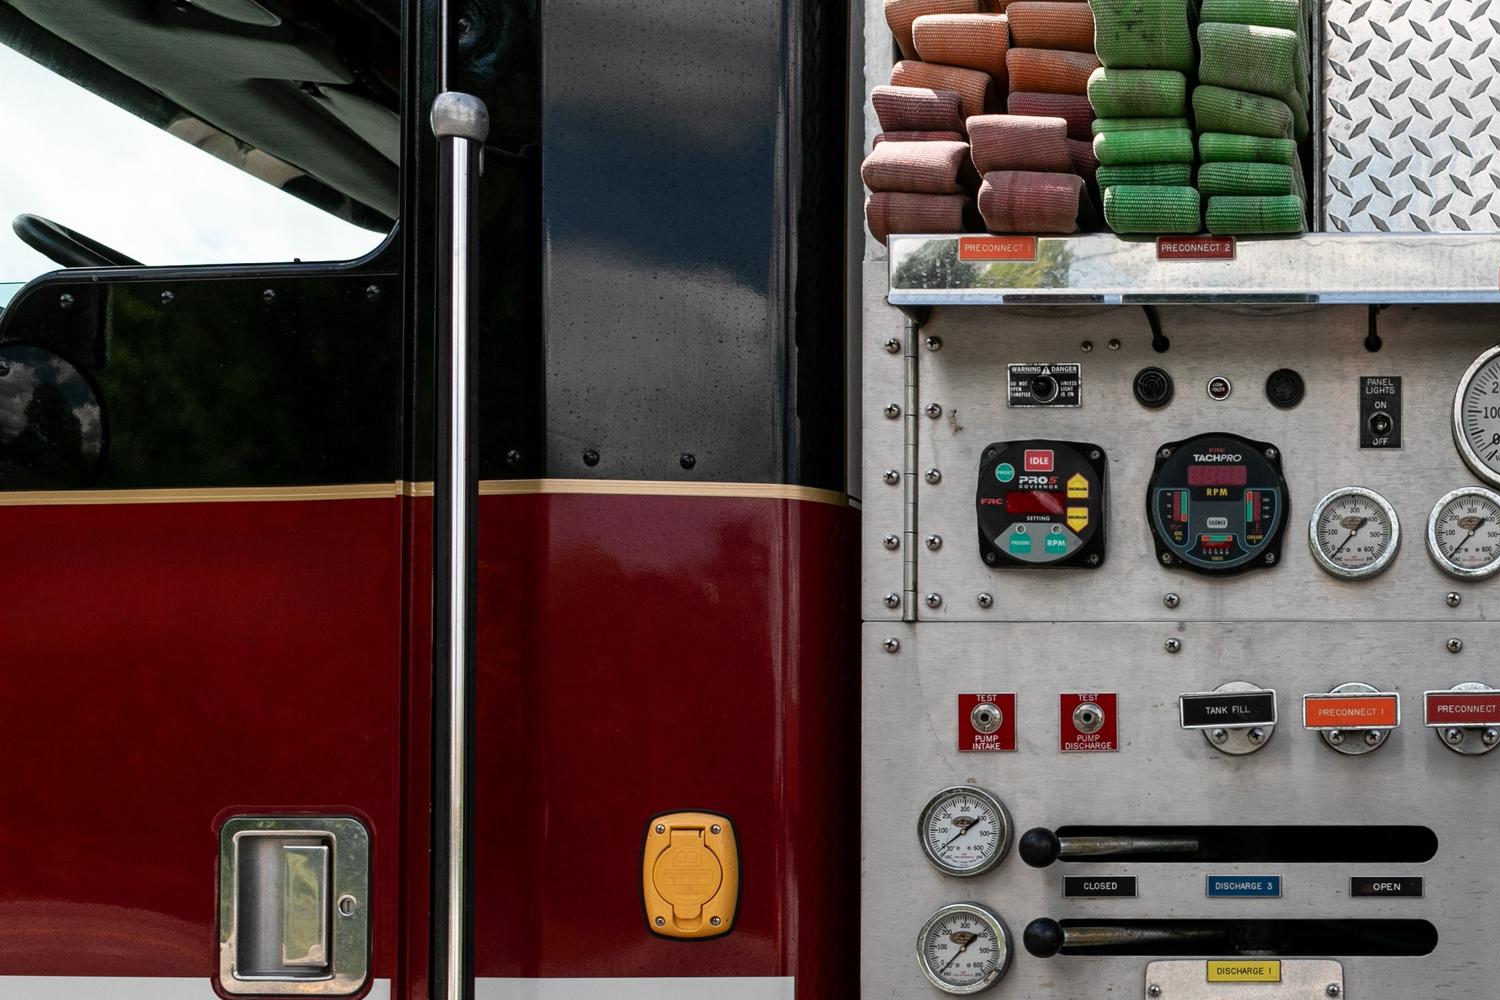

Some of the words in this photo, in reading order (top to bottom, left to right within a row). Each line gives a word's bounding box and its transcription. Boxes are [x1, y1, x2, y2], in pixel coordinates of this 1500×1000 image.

[964, 243, 1024, 252] PRECONNECT
[1161, 244, 1220, 252] PRECONNECT
[1224, 244, 1231, 252] 2
[1367, 378, 1393, 386] PANEL
[1374, 401, 1387, 409] ON
[1373, 438, 1388, 446] OFF
[1493, 433, 1500, 444] 0
[1193, 454, 1242, 462] TACHPRO
[1206, 488, 1228, 496] RPM
[1205, 706, 1227, 715] TANK
[1232, 705, 1250, 714] FILL
[1318, 708, 1376, 717] PRECONNECT
[1437, 704, 1496, 713] PRECONNECT
[1065, 742, 1112, 750] DISCHARGE
[1083, 882, 1118, 890] CLOSED
[1215, 882, 1262, 890] DISCHARGE
[1267, 882, 1273, 890] 3
[1373, 883, 1401, 891] OPEN
[1217, 967, 1264, 975] DISCHARGE
